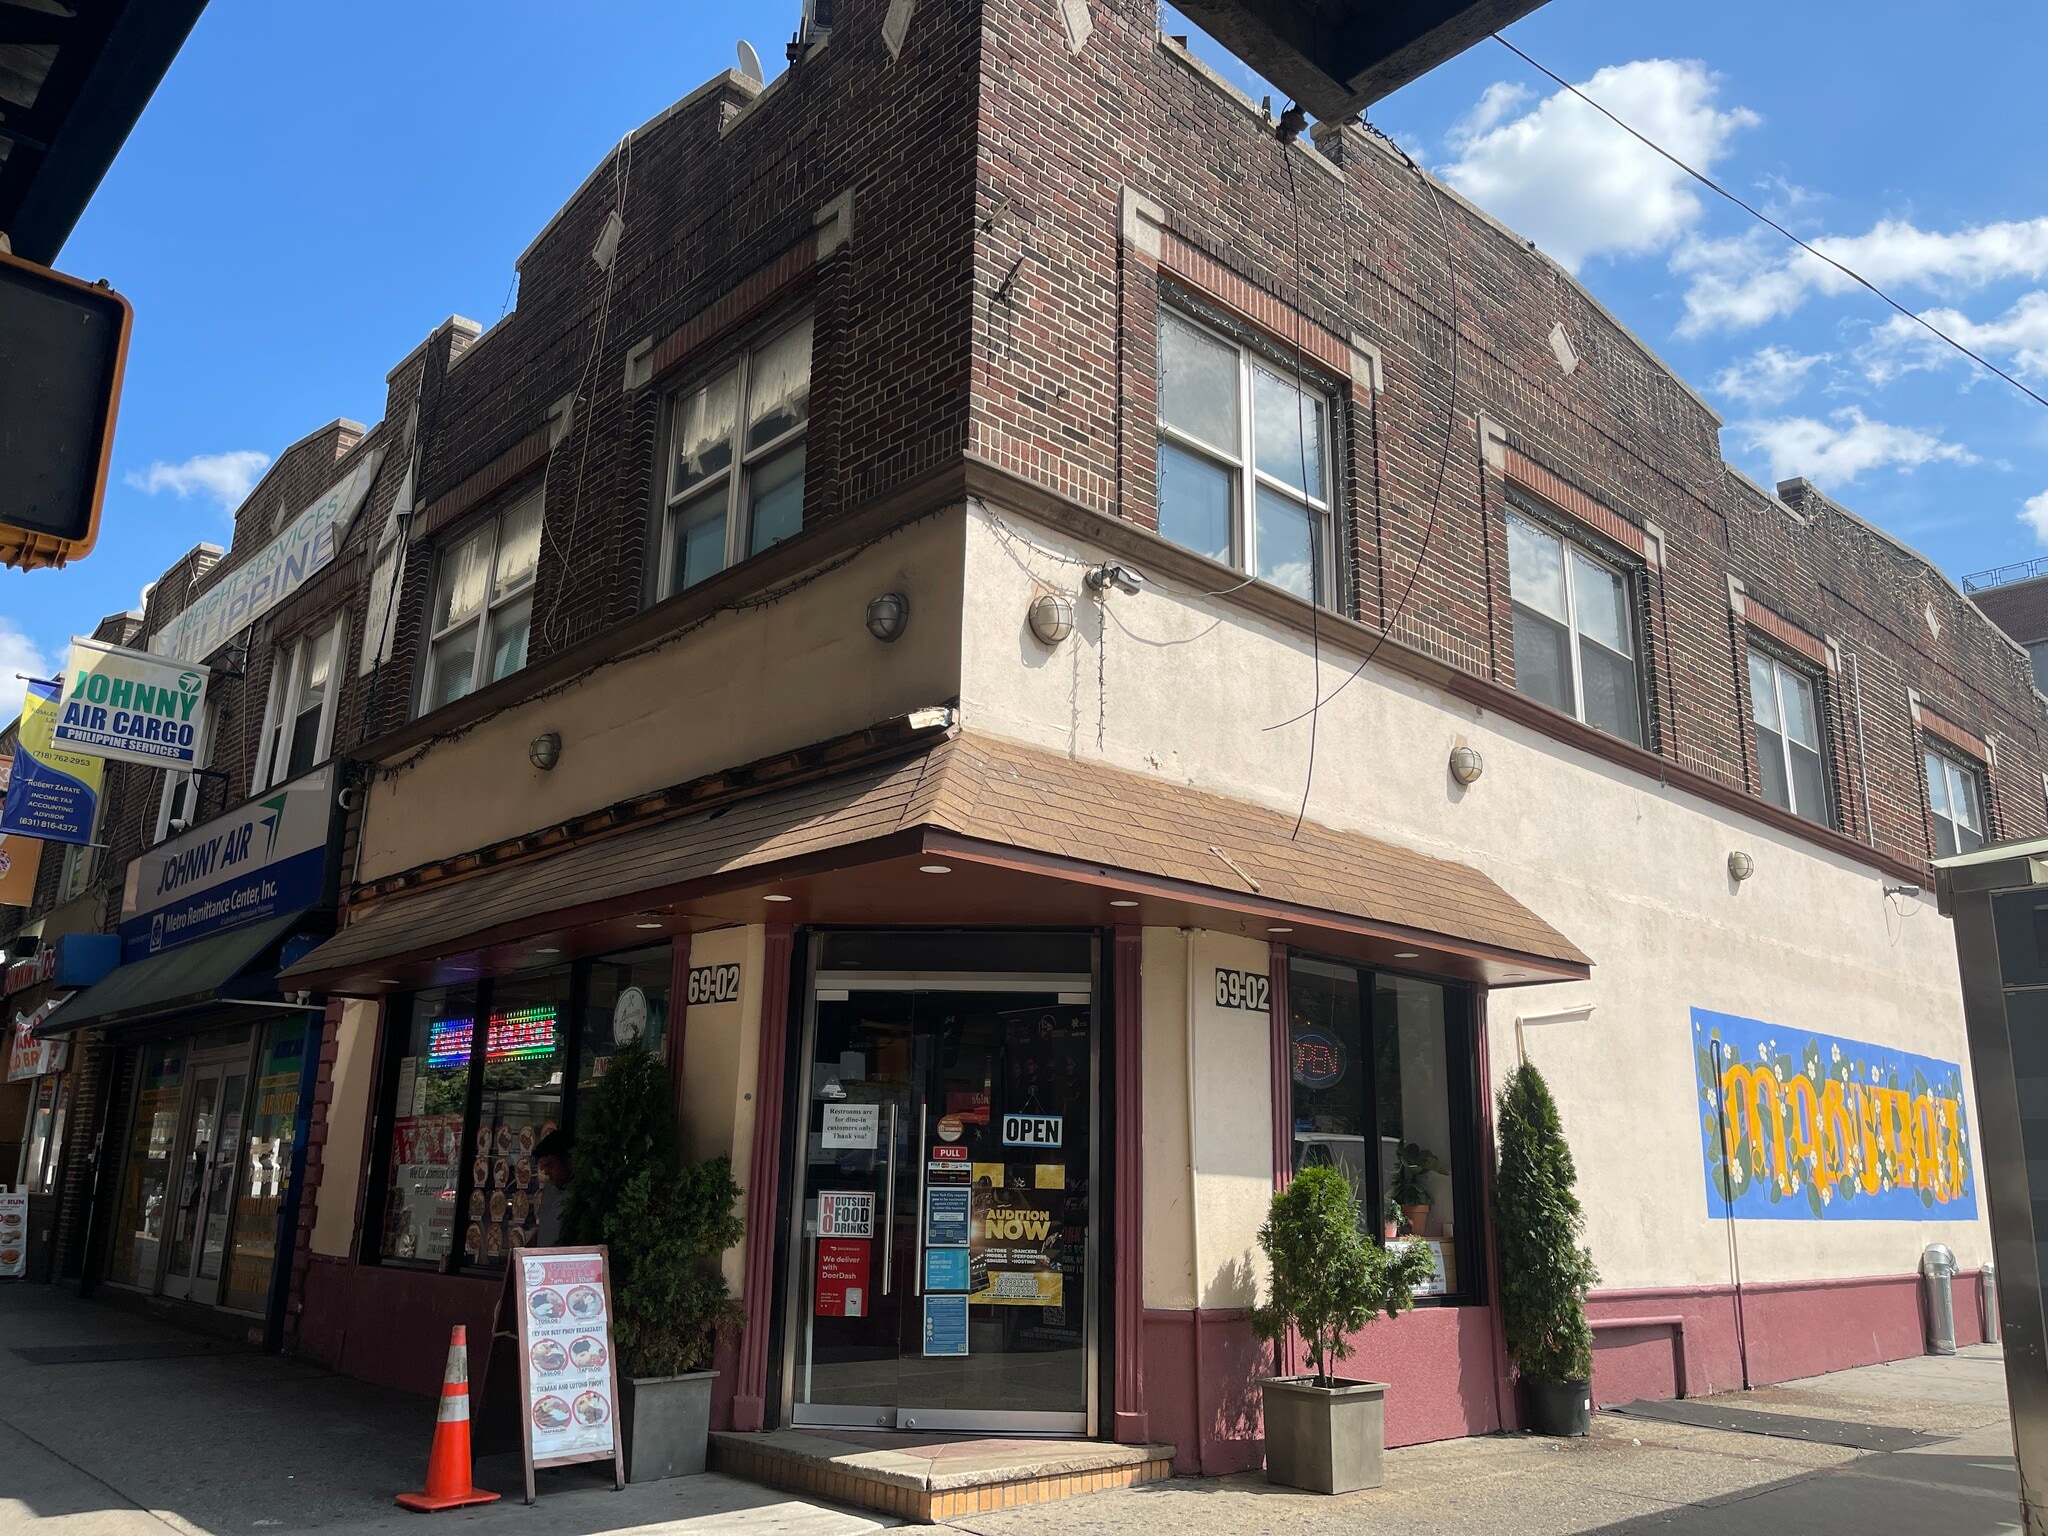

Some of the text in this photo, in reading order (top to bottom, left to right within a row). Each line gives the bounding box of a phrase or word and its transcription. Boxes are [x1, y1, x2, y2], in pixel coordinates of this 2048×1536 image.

[175, 493, 340, 639] FREIGHT SERVICES
[71, 670, 199, 721] JOHNNY
[64, 702, 194, 746] AIR CARGO
[67, 728, 180, 758] PHILIPPINE SERVICES
[33, 750, 91, 767] (718) 762-2953
[31, 792, 74, 804] INCOME TAX
[28, 801, 74, 813] ACCOUNTING
[34, 811, 65, 821] ADVISOR
[20, 817, 78, 833] (631) 816-4372
[157, 822, 253, 896] JOHNNY AIR
[165, 911, 187, 933] Metro
[188, 895, 230, 927] Remittance
[231, 885, 260, 910] Center,
[261, 879, 277, 900] Inc.
[688, 966, 739, 1003] 69-02
[1216, 971, 1270, 1010] 69-02
[1006, 1118, 1059, 1143] OPEN
[940, 1149, 960, 1157] PULL
[835, 1196, 871, 1207] OUTSIDE
[823, 1196, 835, 1233] NO
[834, 1207, 869, 1222] FOOD
[986, 1208, 1050, 1221] AUDITION
[834, 1222, 869, 1234] DRINKS
[984, 1220, 1051, 1241] NOW
[822, 1263, 837, 1271] with
[823, 1255, 835, 1263] We
